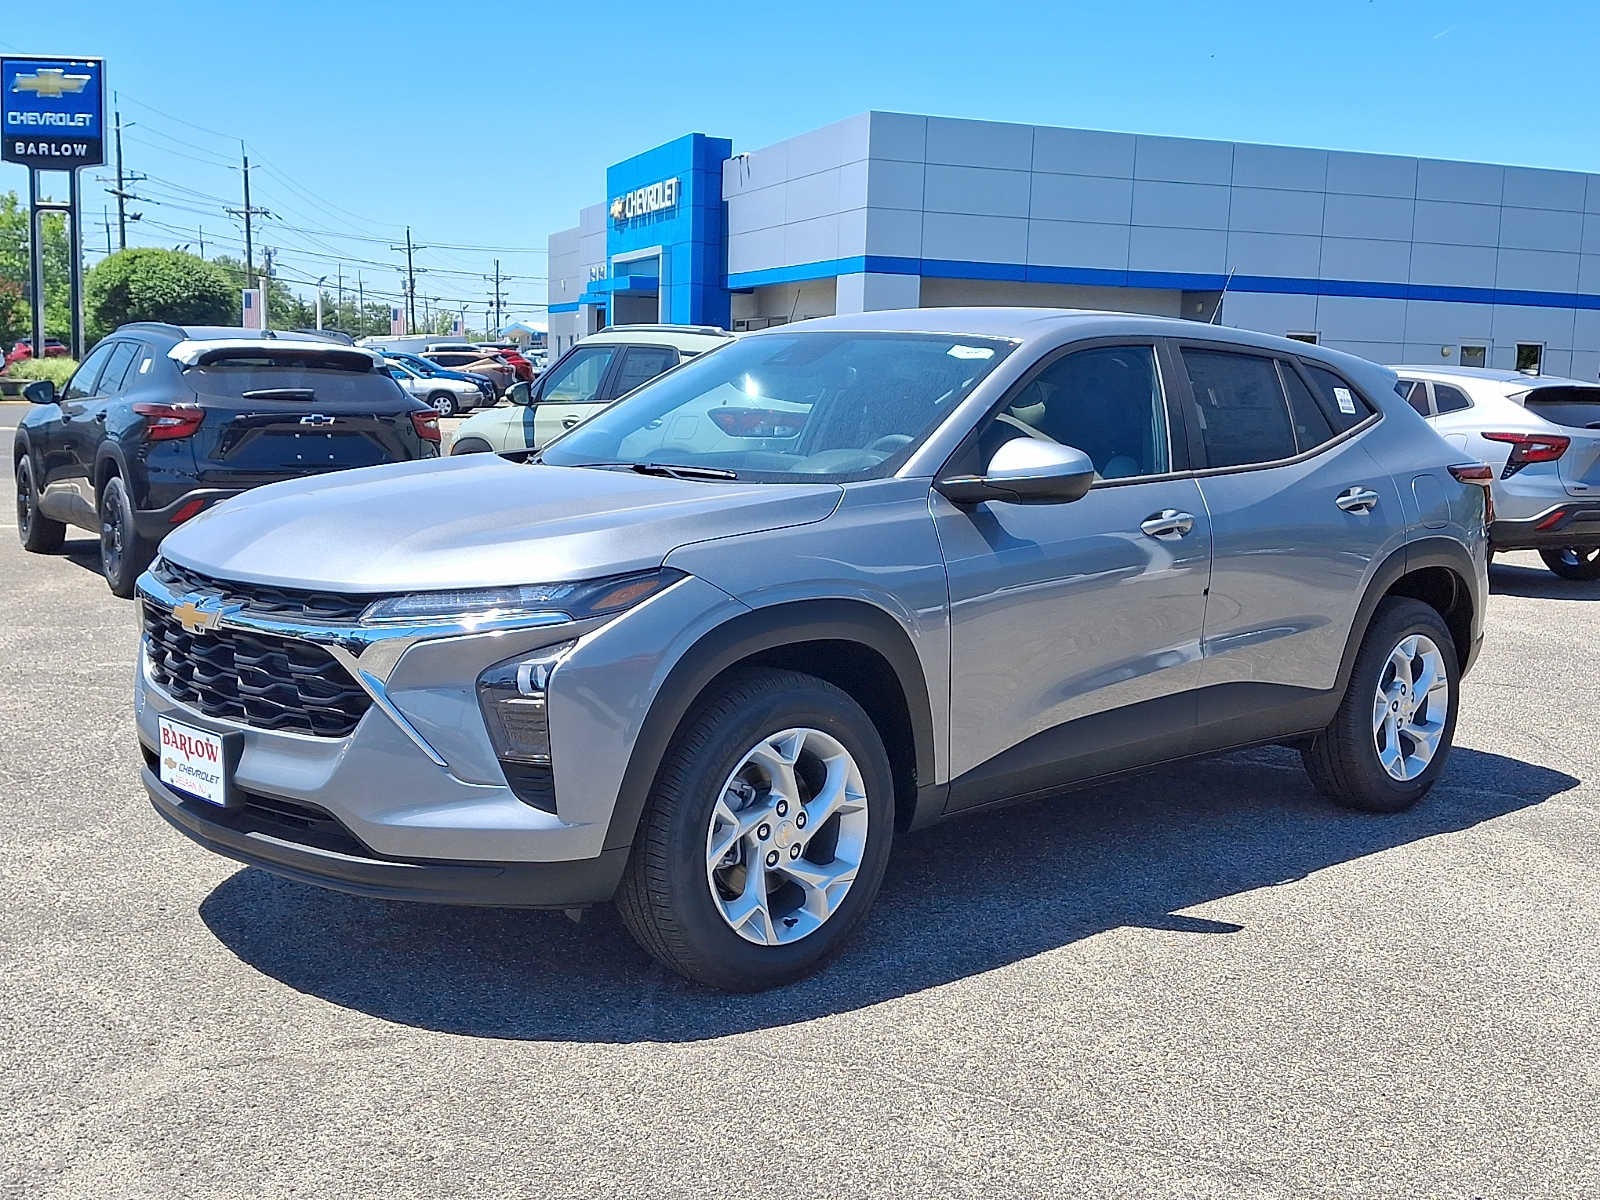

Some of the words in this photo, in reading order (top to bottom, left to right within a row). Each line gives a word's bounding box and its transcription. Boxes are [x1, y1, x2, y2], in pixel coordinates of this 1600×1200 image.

[7, 111, 93, 126] CHEVROLET
[15, 141, 87, 156] BARLOW
[625, 176, 679, 218] CHEVROLET
[162, 727, 219, 763] BARLOW
[178, 763, 220, 785] CHEVROLET
